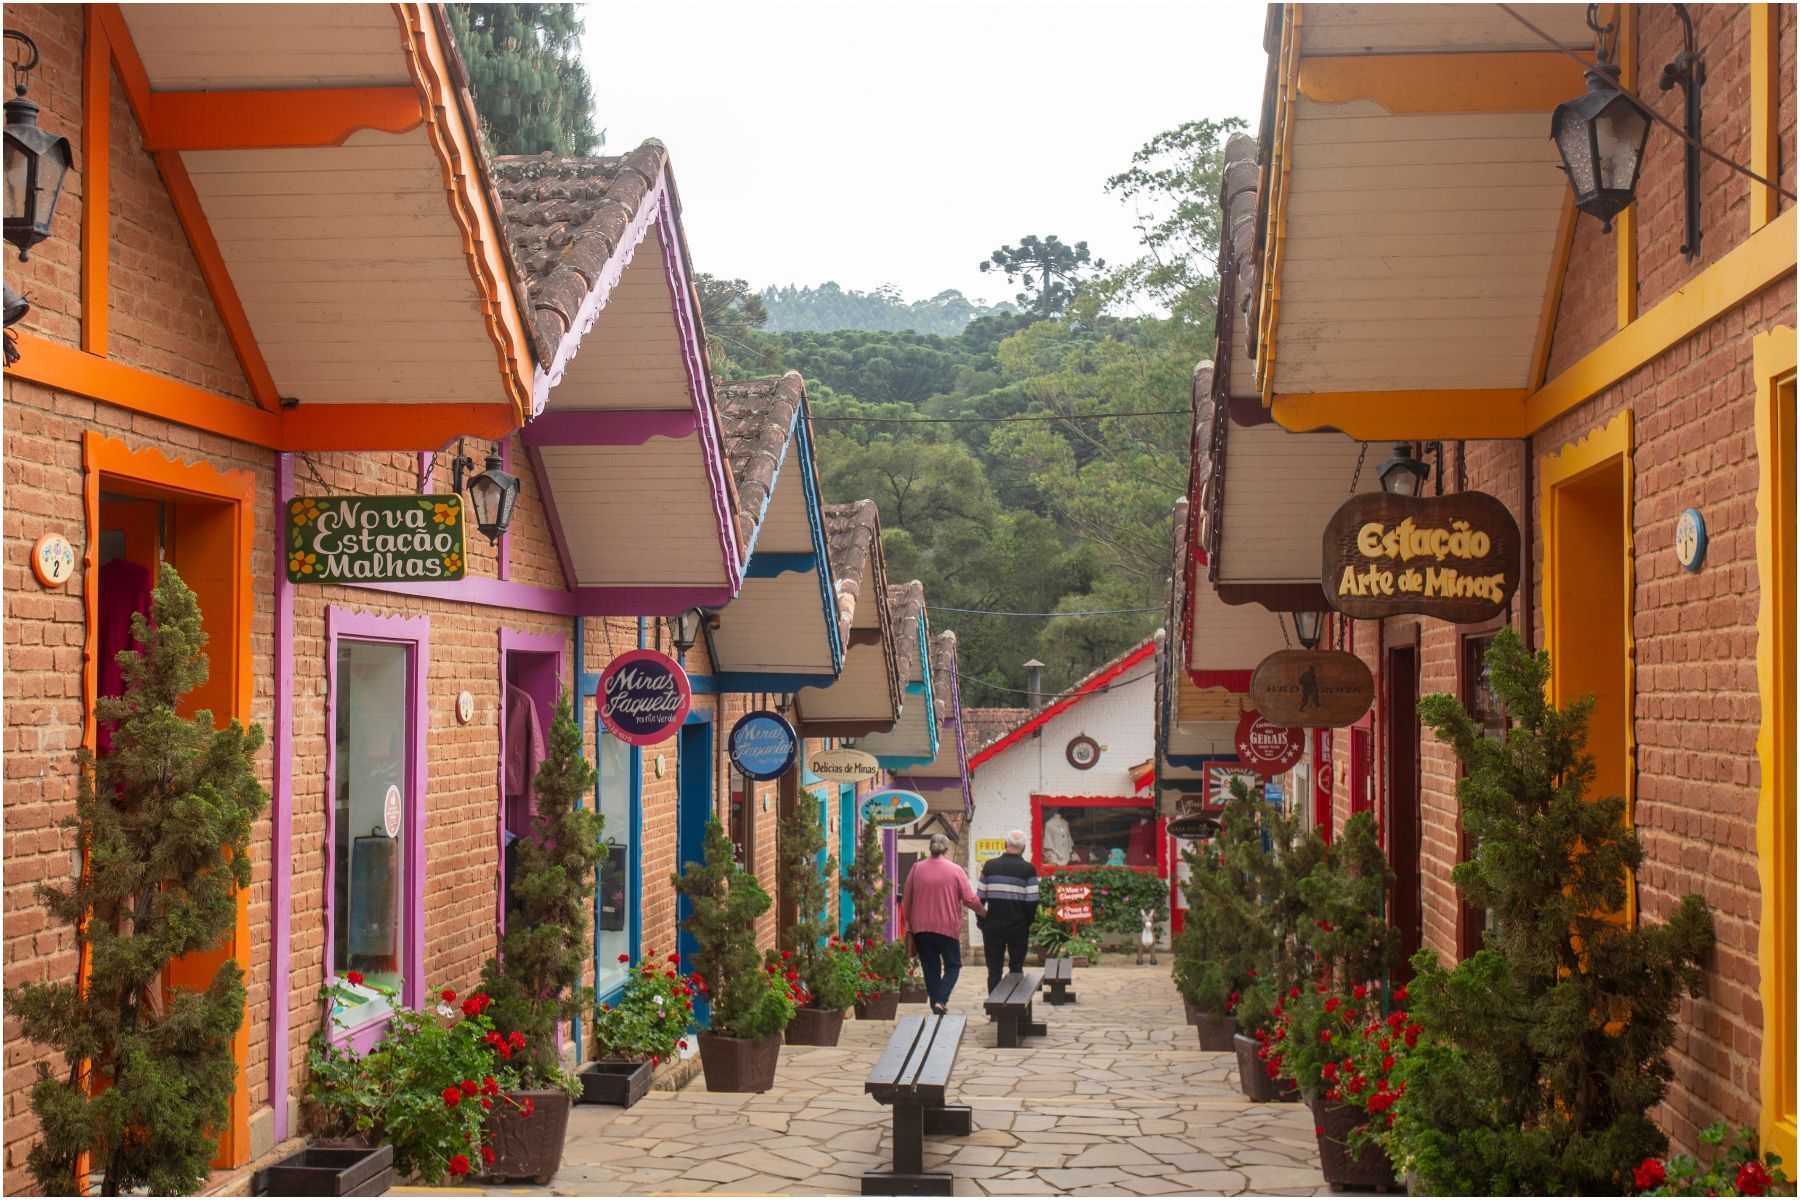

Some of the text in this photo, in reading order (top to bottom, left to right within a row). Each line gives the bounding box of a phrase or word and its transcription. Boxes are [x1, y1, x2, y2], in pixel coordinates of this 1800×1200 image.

[331, 500, 426, 529] Nova
[312, 511, 452, 555] Estação
[1357, 516, 1491, 562] Estação
[53, 560, 60, 578] 2
[319, 552, 442, 579] Malhas
[1338, 564, 1506, 605] Arte de Minas
[604, 667, 675, 695] Minas
[1266, 685, 1363, 694] WILD ROVER
[601, 690, 687, 718] Jaquetas
[733, 723, 786, 743] Minas
[1250, 731, 1288, 745] GERAIS
[731, 739, 794, 761] Jaquetas
[844, 763, 853, 774] de
[854, 763, 877, 775] Minas
[979, 840, 1007, 851] FRITU
